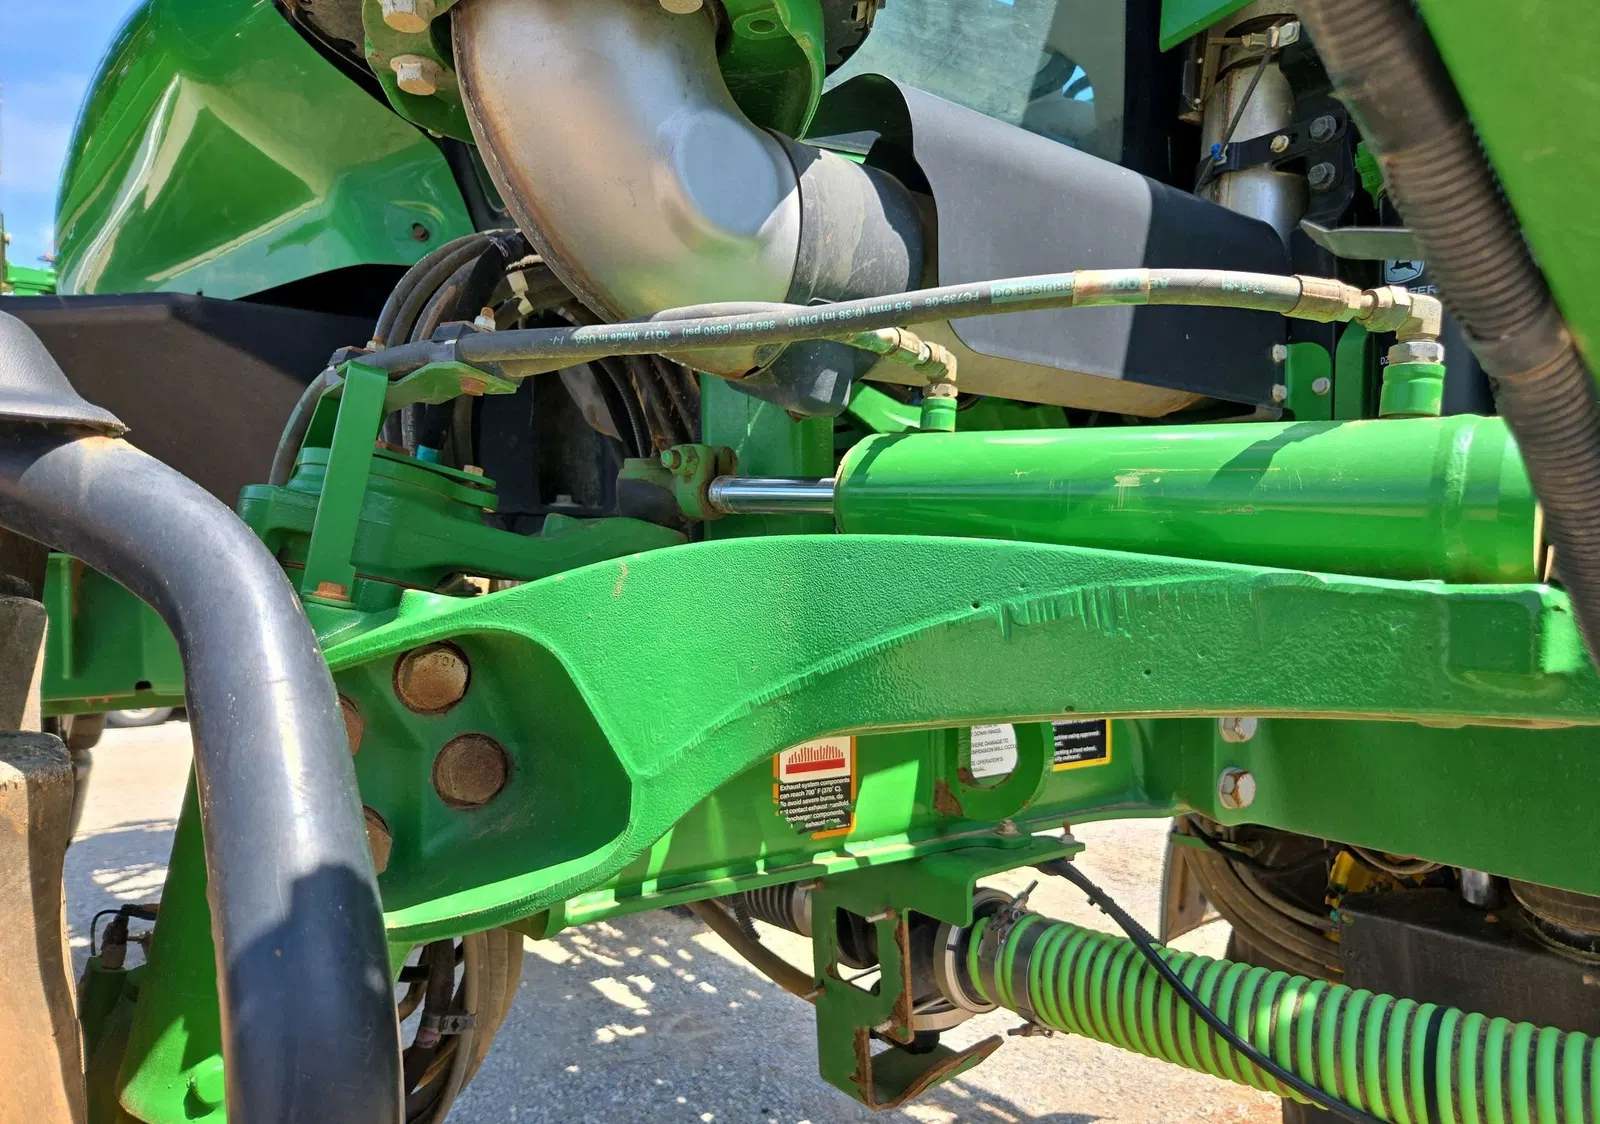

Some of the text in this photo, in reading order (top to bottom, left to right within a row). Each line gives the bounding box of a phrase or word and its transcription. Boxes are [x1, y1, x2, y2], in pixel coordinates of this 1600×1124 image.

[1016, 282, 1072, 296] BRUISER
[925, 291, 979, 308] FC735-06
[870, 304, 892, 314] mm
[895, 301, 912, 311] 9.5
[822, 311, 835, 323] in)
[838, 306, 865, 319] (0.38
[756, 320, 776, 330] 366
[788, 314, 818, 327] DN10
[704, 325, 732, 336] (5300
[735, 322, 753, 331] bar
[599, 333, 608, 342] in
[610, 331, 638, 341] Made
[644, 330, 670, 340] 4Q17
[682, 327, 700, 338] psi)
[574, 334, 596, 344] USA
[976, 757, 1003, 765] OPERATOR'S
[780, 778, 850, 791] Exhaust system components
[791, 790, 805, 798] reach
[805, 820, 825, 828] exhaust
